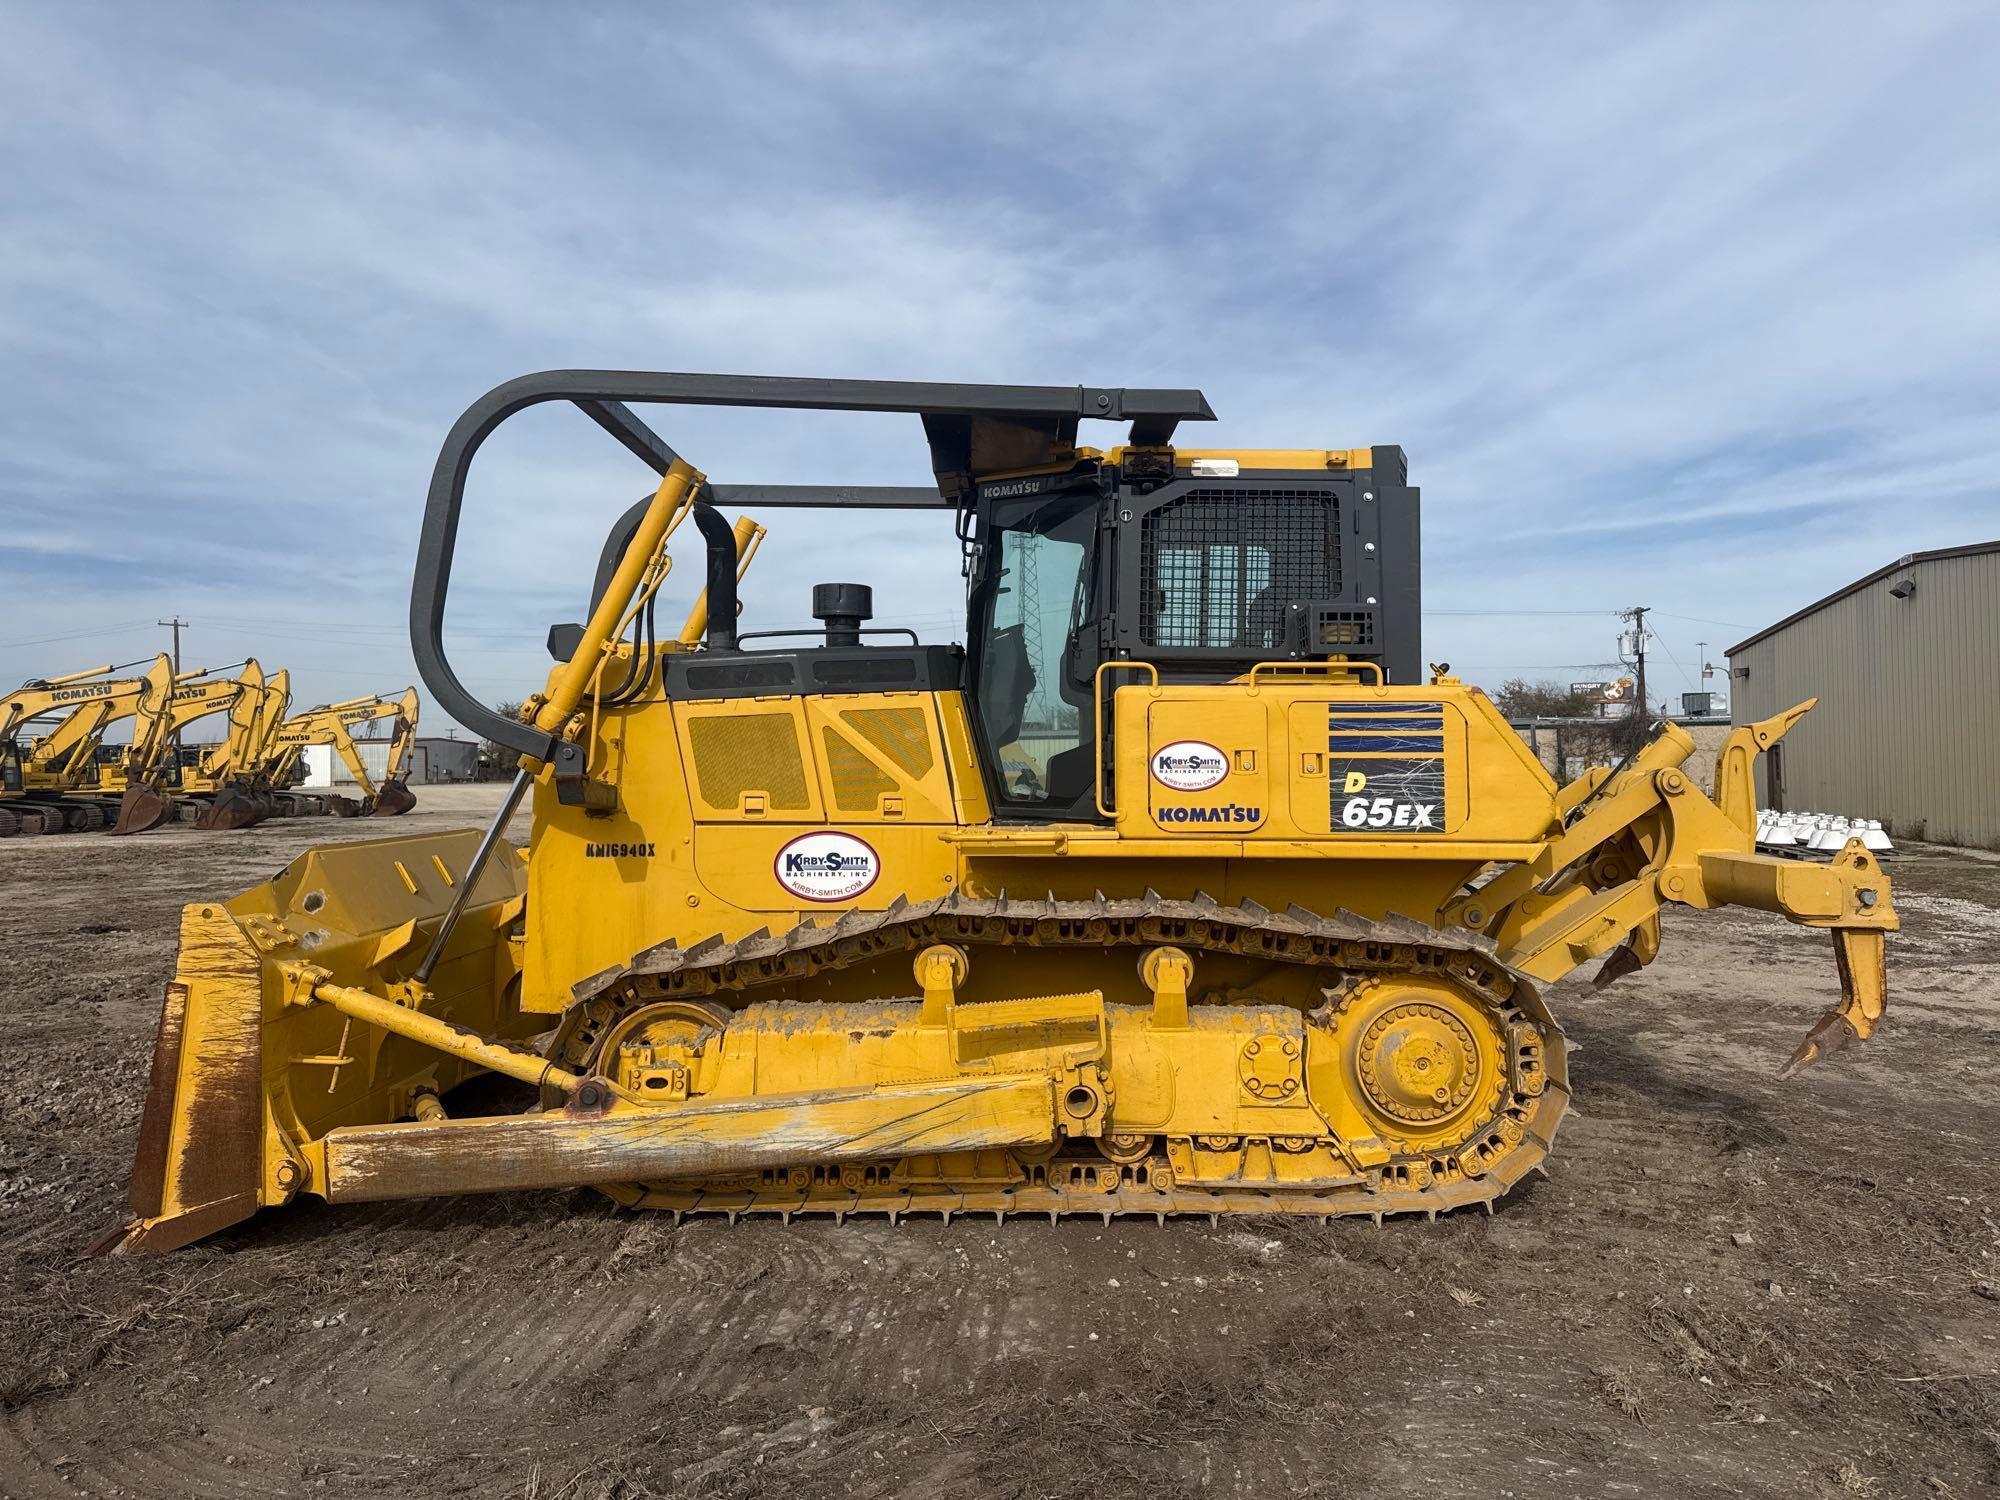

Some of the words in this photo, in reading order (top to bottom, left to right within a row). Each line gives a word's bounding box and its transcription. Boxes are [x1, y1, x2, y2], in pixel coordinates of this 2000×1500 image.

[984, 481, 1040, 497] KOMATSU
[52, 685, 112, 701] KOMATSU
[1159, 756, 1220, 769] KIRBY-SMITH
[1344, 772, 1367, 793] D
[1159, 804, 1260, 822] KOMATSU
[1343, 798, 1437, 827] 65EX
[786, 853, 868, 871] KIRBY-SMITH
[792, 881, 864, 896] KIRBY-SMITH.COM
